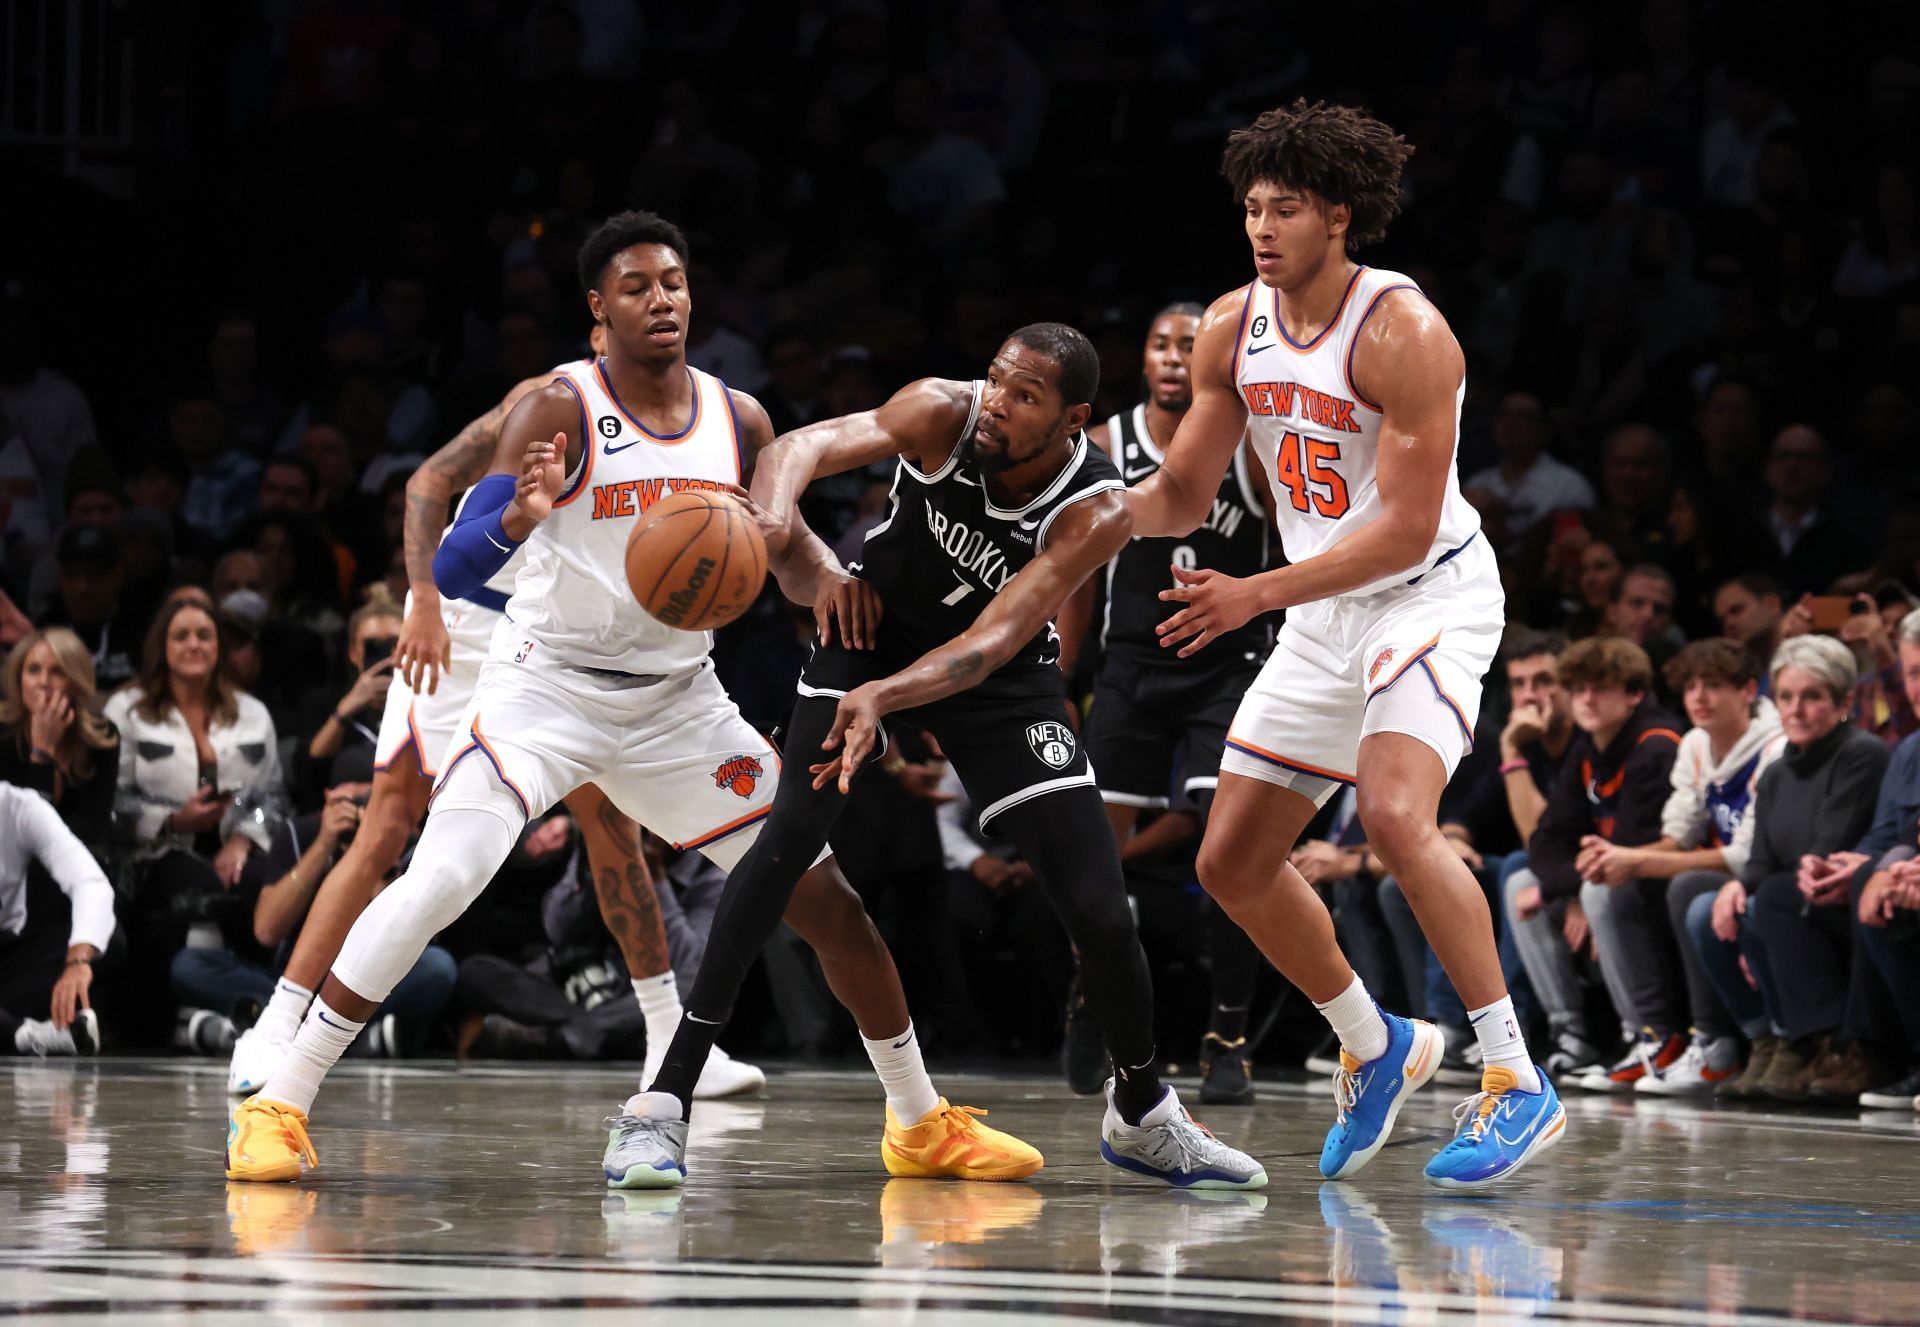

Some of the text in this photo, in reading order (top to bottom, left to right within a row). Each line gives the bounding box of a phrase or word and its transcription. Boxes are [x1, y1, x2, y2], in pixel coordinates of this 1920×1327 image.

[602, 418, 616, 436] 6
[1242, 382, 1361, 433] NEW YORK
[1277, 431, 1351, 520] 45
[592, 478, 665, 520] NEW
[925, 498, 1018, 594] BROOKLY
[1010, 529, 1033, 545] Webull
[940, 568, 975, 607] 7
[1030, 724, 1075, 746] NETS
